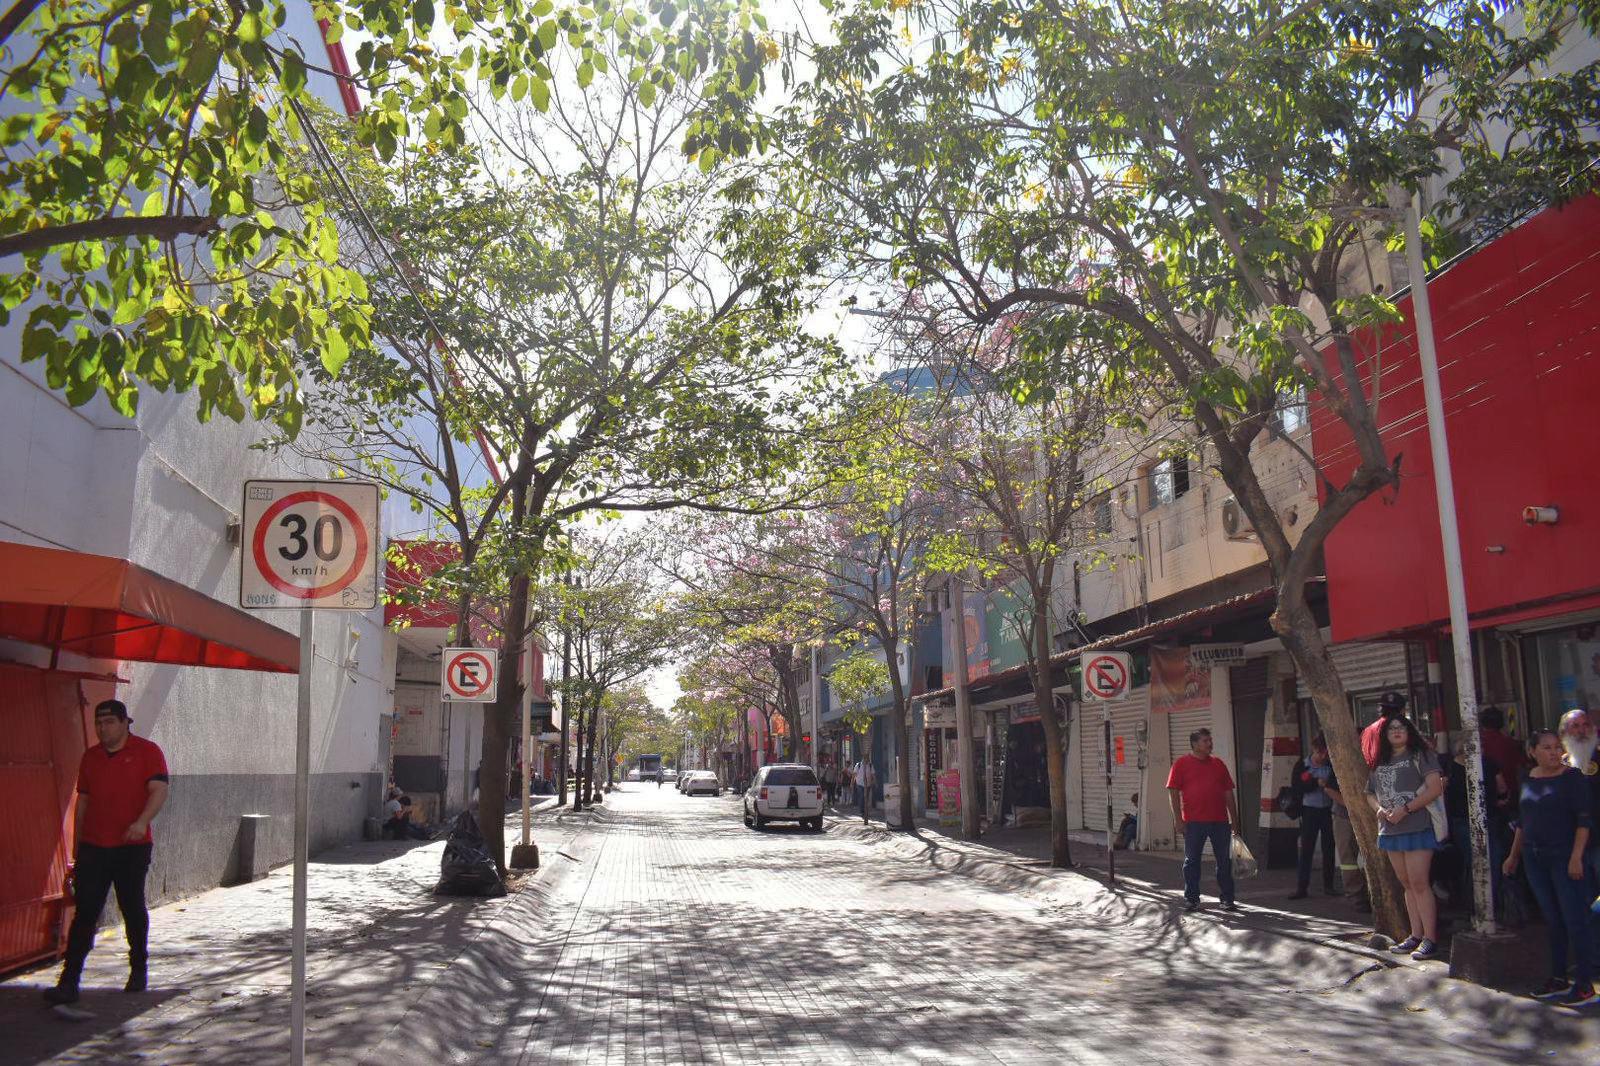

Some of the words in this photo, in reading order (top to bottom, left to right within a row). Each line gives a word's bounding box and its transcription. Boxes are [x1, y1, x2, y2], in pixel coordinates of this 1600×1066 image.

[278, 513, 343, 562] 30
[291, 565, 328, 576] km/h
[460, 661, 479, 687] E
[1097, 664, 1114, 689] E
